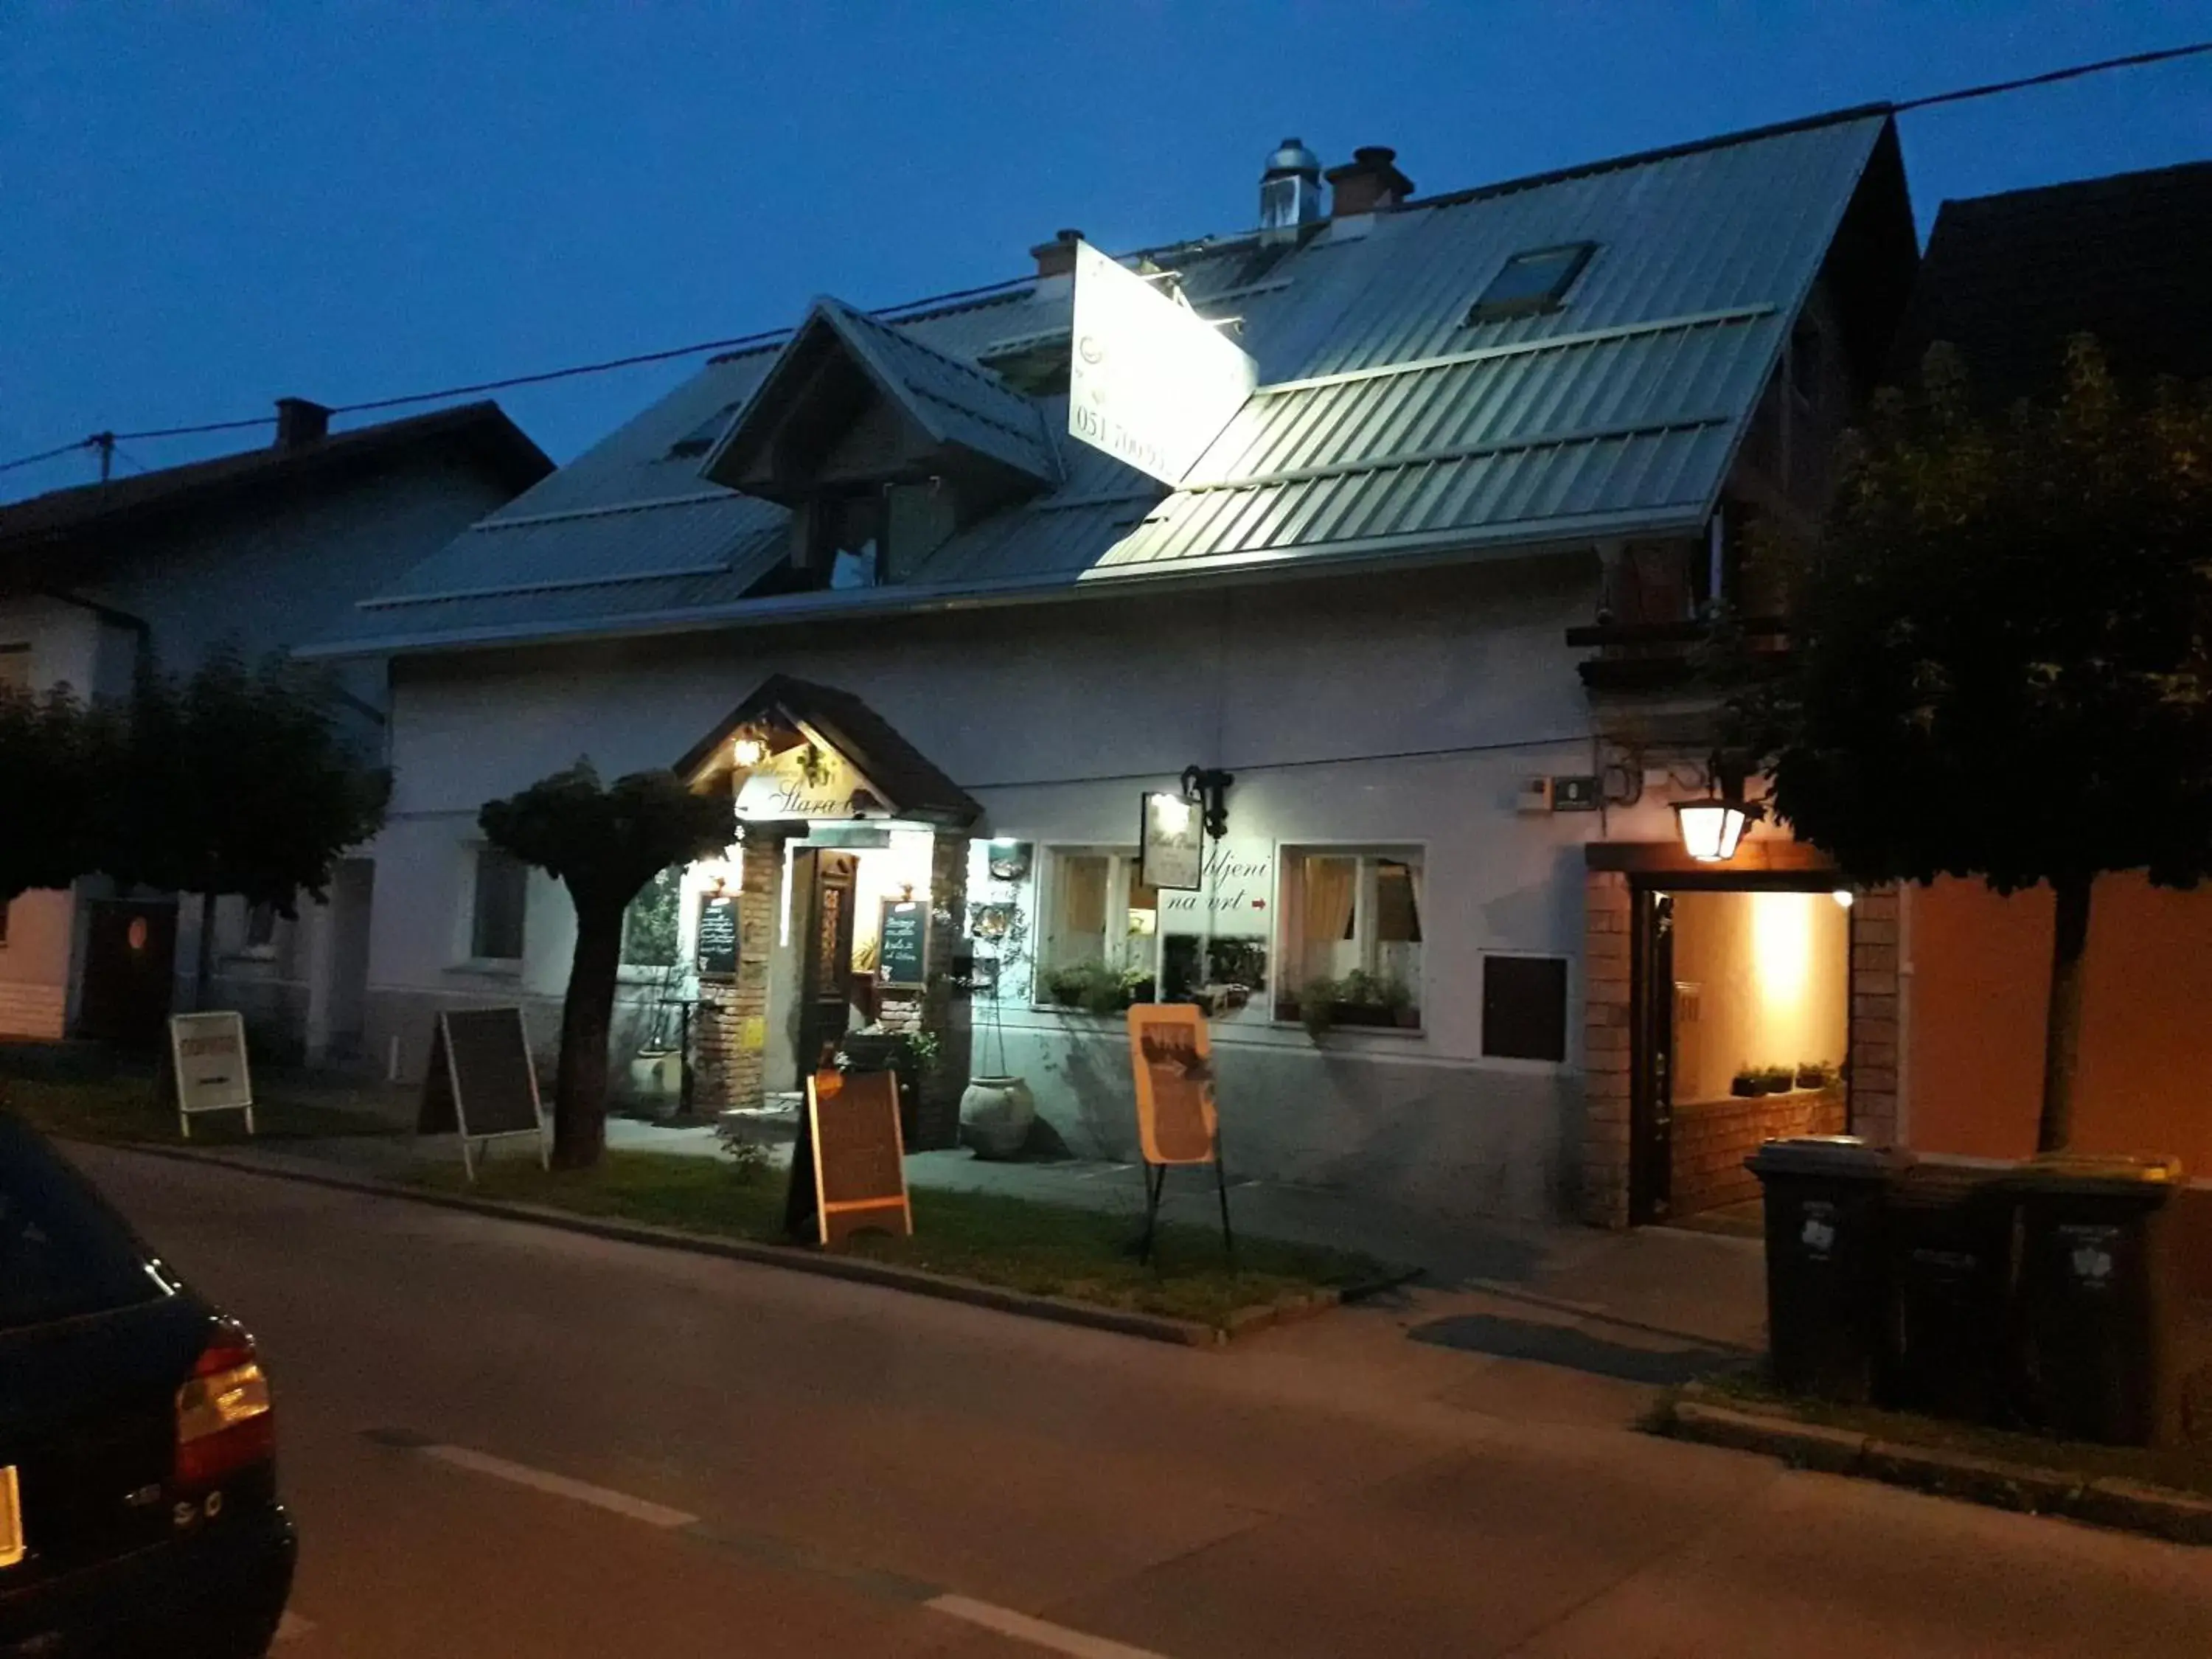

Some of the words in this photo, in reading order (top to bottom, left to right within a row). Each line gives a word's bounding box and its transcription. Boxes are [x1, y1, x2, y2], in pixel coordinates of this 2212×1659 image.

[1077, 404, 1105, 442] 051
[768, 776, 835, 814] Stara
[1203, 847, 1271, 888] bljeni
[1167, 896, 1197, 911] na
[1207, 888, 1248, 911] vrt
